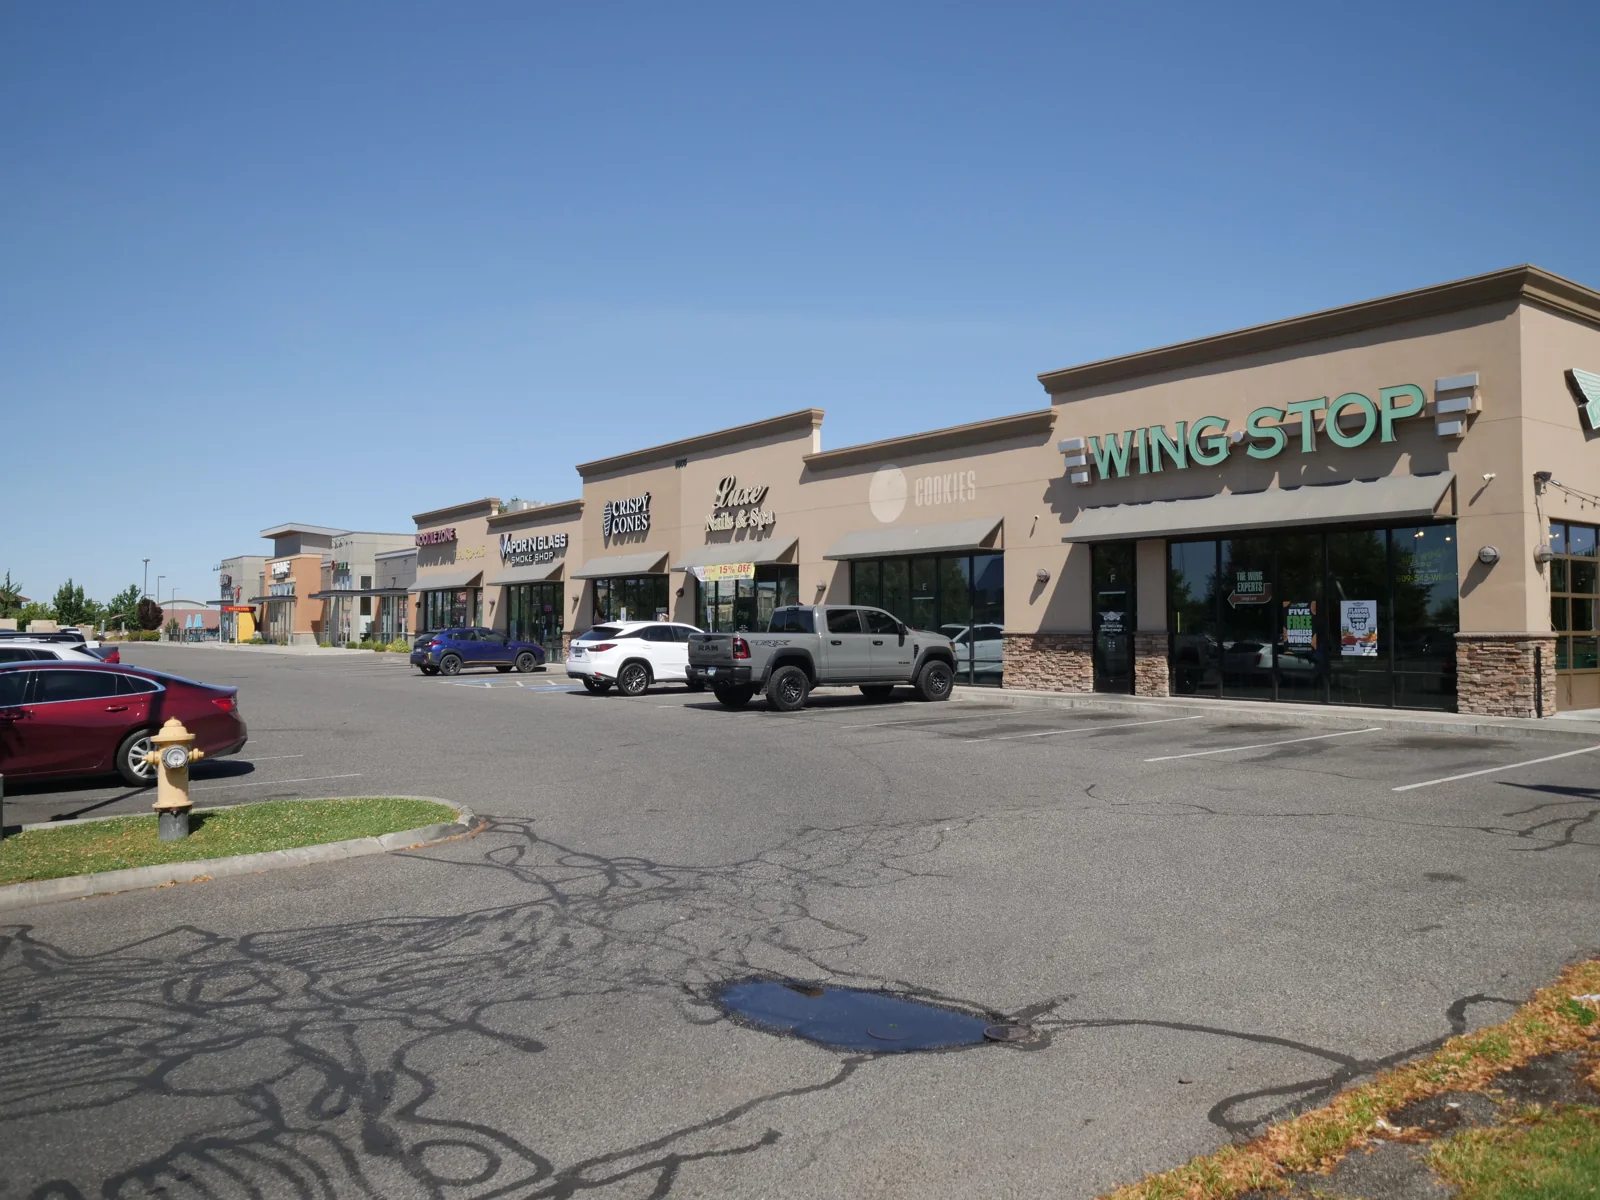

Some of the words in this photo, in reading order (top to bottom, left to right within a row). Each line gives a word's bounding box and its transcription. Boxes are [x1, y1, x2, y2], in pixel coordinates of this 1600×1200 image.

[1088, 416, 1231, 480] WING
[1246, 383, 1427, 460] STOP
[712, 475, 768, 508] Luxe
[915, 470, 976, 507] COOKIES
[612, 493, 649, 516] CRISPY
[612, 514, 649, 534] CONES
[705, 512, 734, 531] Nails
[735, 509, 750, 528] &
[750, 507, 775, 531] Spa
[537, 533, 567, 550] GLASS
[511, 553, 533, 564] SMOKE
[534, 551, 554, 561] SHOP
[719, 565, 735, 575] 15%
[738, 564, 752, 573] OFF
[1110, 574, 1116, 583] F
[1236, 571, 1247, 581] THE
[1247, 571, 1263, 581] WING
[922, 582, 927, 591] E
[1237, 581, 1263, 593] EXPERTS
[1288, 608, 1311, 616] FIVE
[1287, 615, 1312, 630] FREE
[1352, 622, 1365, 631] $10
[1287, 635, 1312, 644] WINGS
[698, 644, 718, 652] RAM
